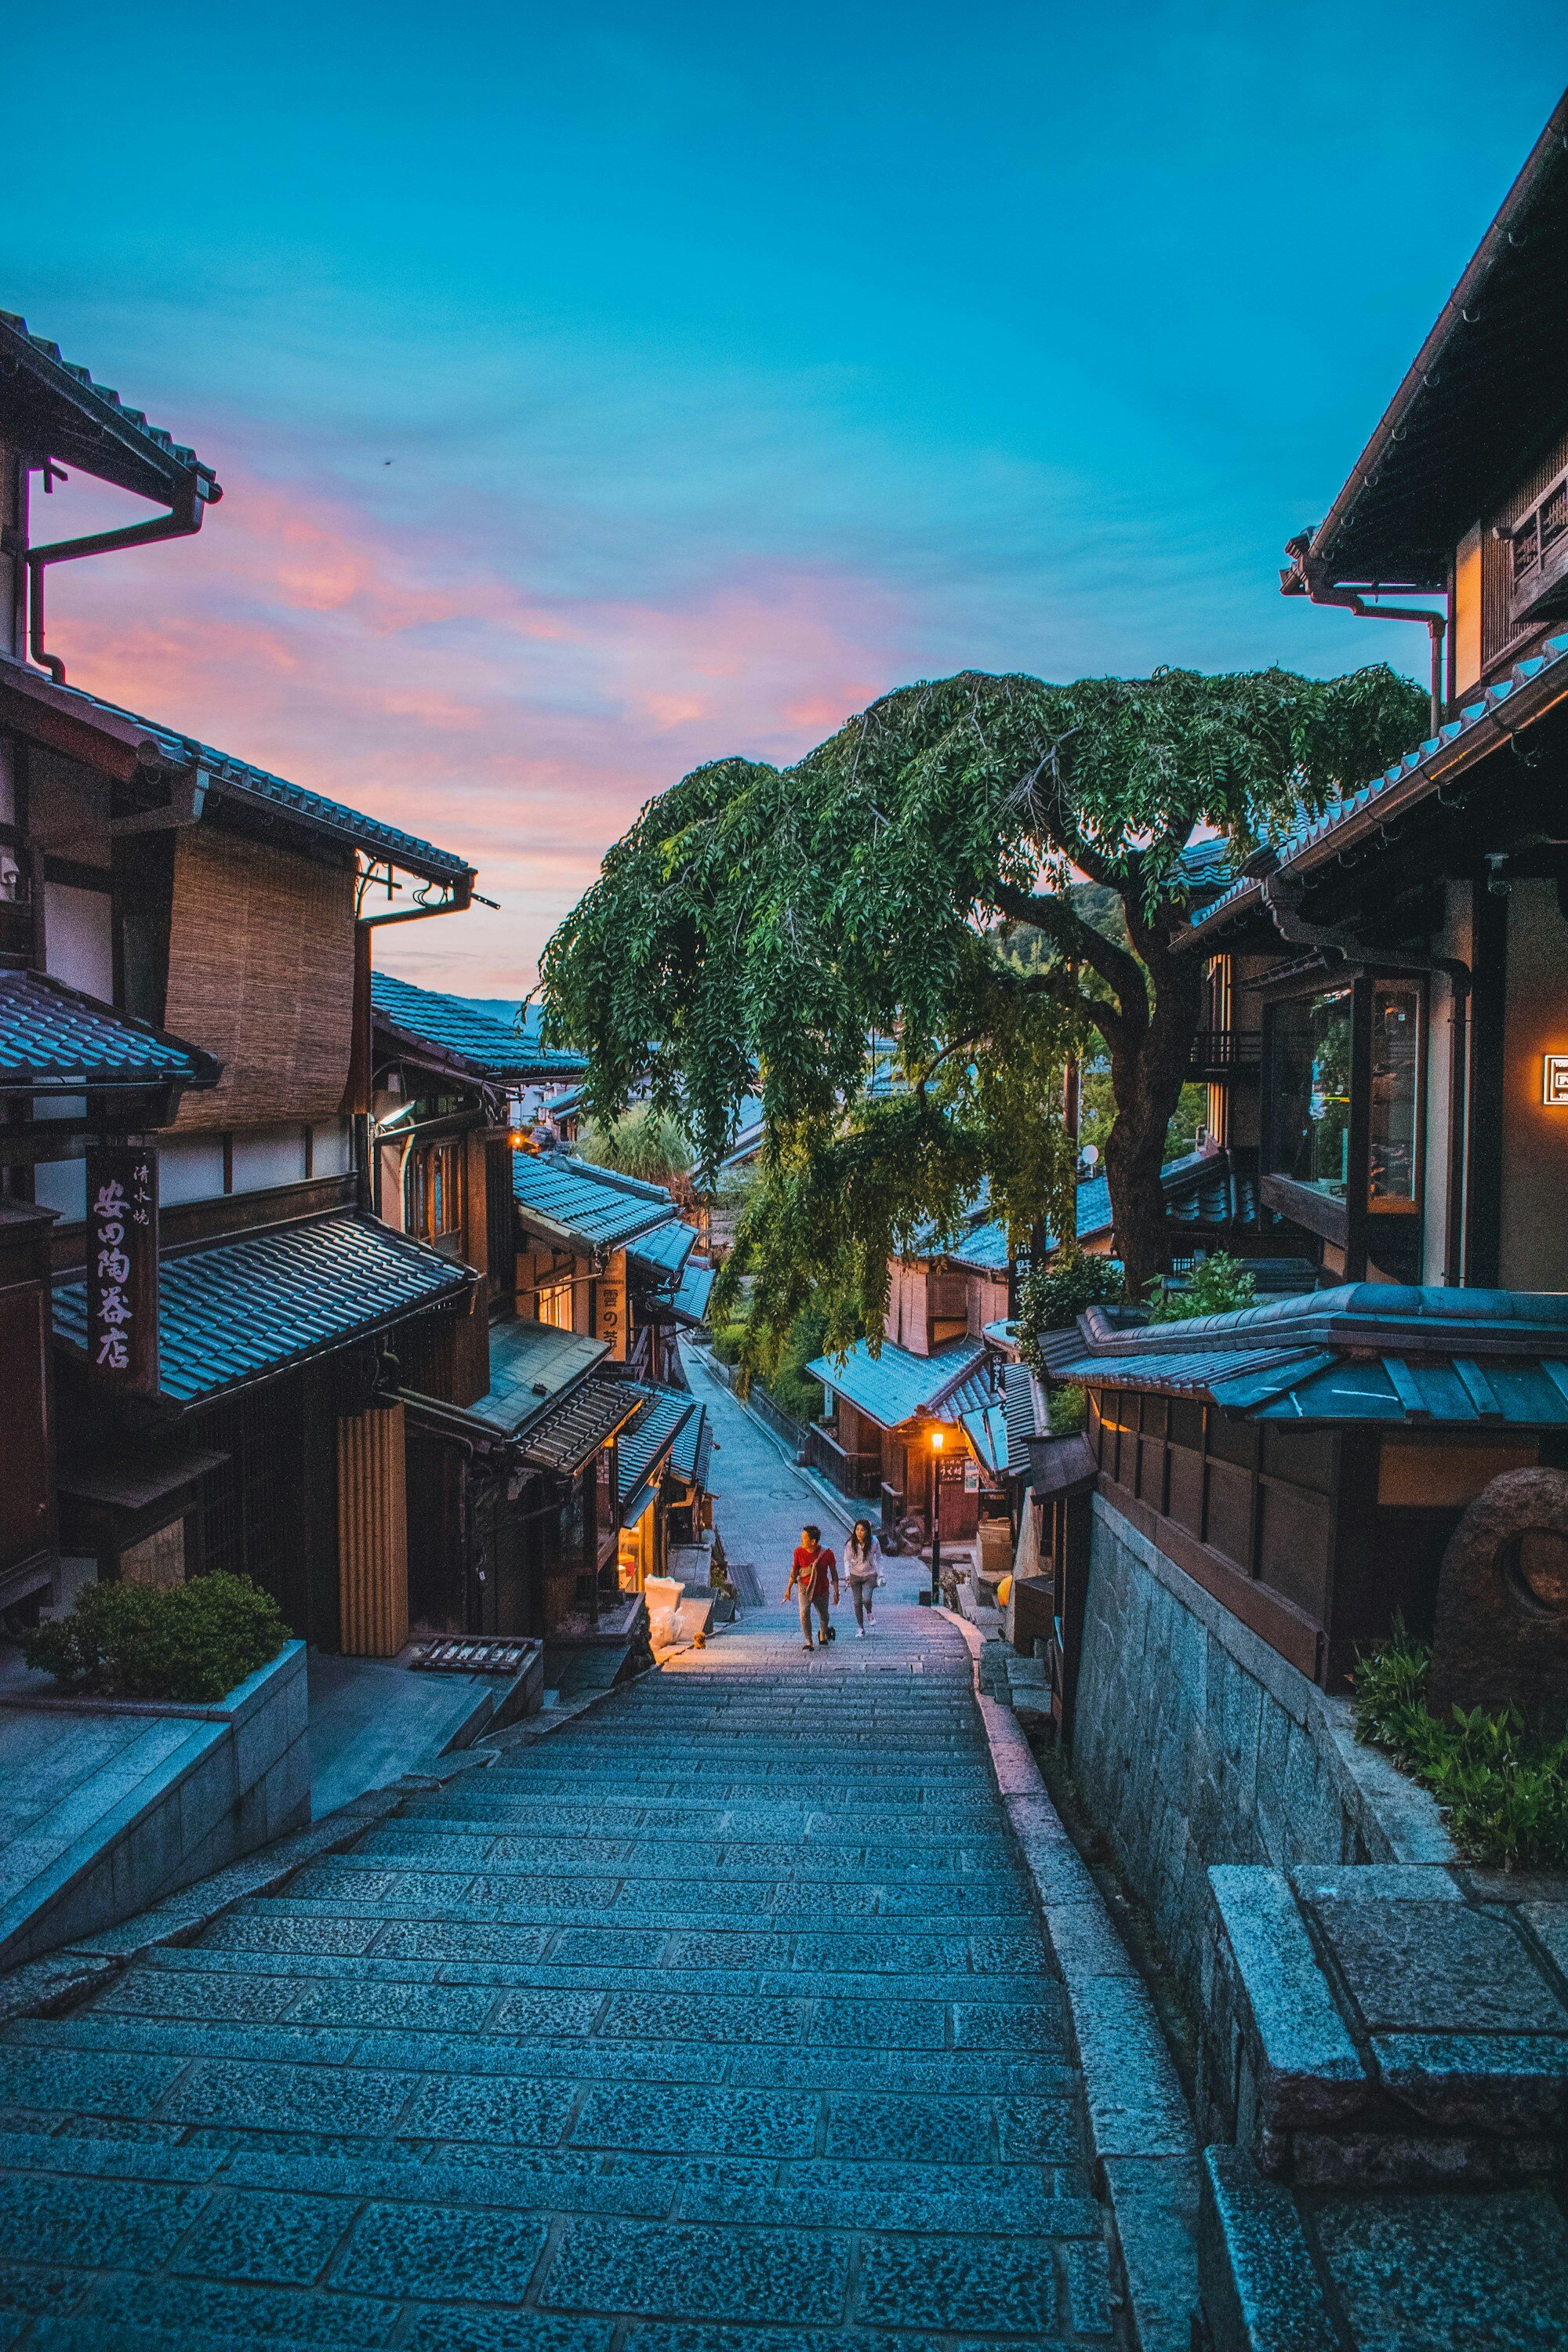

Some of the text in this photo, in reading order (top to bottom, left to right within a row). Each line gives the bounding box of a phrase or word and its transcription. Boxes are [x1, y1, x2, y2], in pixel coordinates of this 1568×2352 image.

[132, 1164, 151, 1226] 清水焼
[93, 1179, 132, 1369] 安田陶器店
